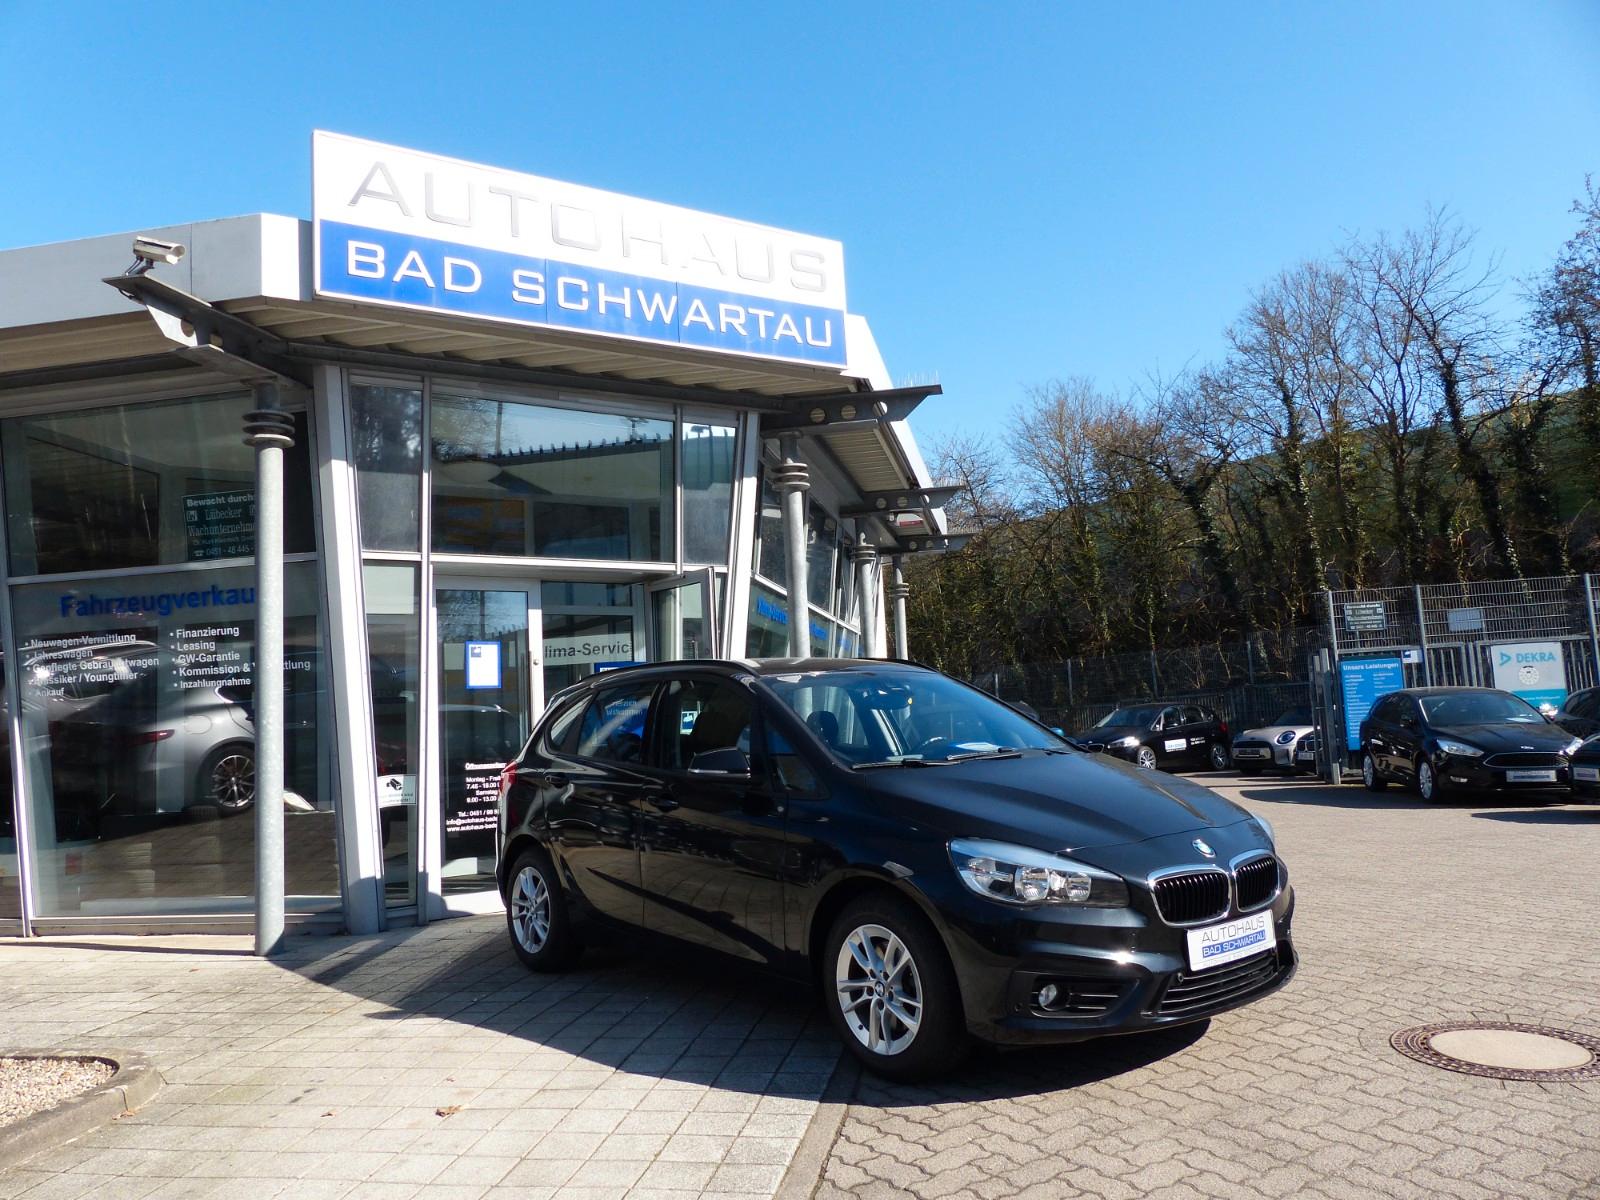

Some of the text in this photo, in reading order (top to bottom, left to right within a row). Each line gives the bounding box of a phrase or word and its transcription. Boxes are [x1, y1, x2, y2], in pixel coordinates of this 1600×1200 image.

[347, 160, 827, 293] AUTOHAUS
[346, 239, 833, 348] BAD SCHWARTAU
[186, 494, 254, 507] Bewacht durch
[60, 585, 255, 618] Fahrzeugverkau
[176, 626, 240, 638] Finanzierung
[31, 634, 137, 649] Neuwagen-Vermittlung
[177, 641, 216, 651] Leasing
[33, 649, 93, 660] Jahreswagen
[544, 641, 632, 658] lima-Servic
[80, 657, 160, 669] Gebrautwagen
[178, 651, 240, 664] GW-Garantie
[1515, 651, 1558, 664] DEKRA
[179, 664, 240, 676] Kommission
[242, 662, 251, 672] &
[180, 677, 251, 689] Inzahlungnahme
[36, 687, 65, 697] Ankauf
[1201, 916, 1265, 944] AUTOHAUS
[1203, 931, 1266, 957] BAD SCHWARTAU
